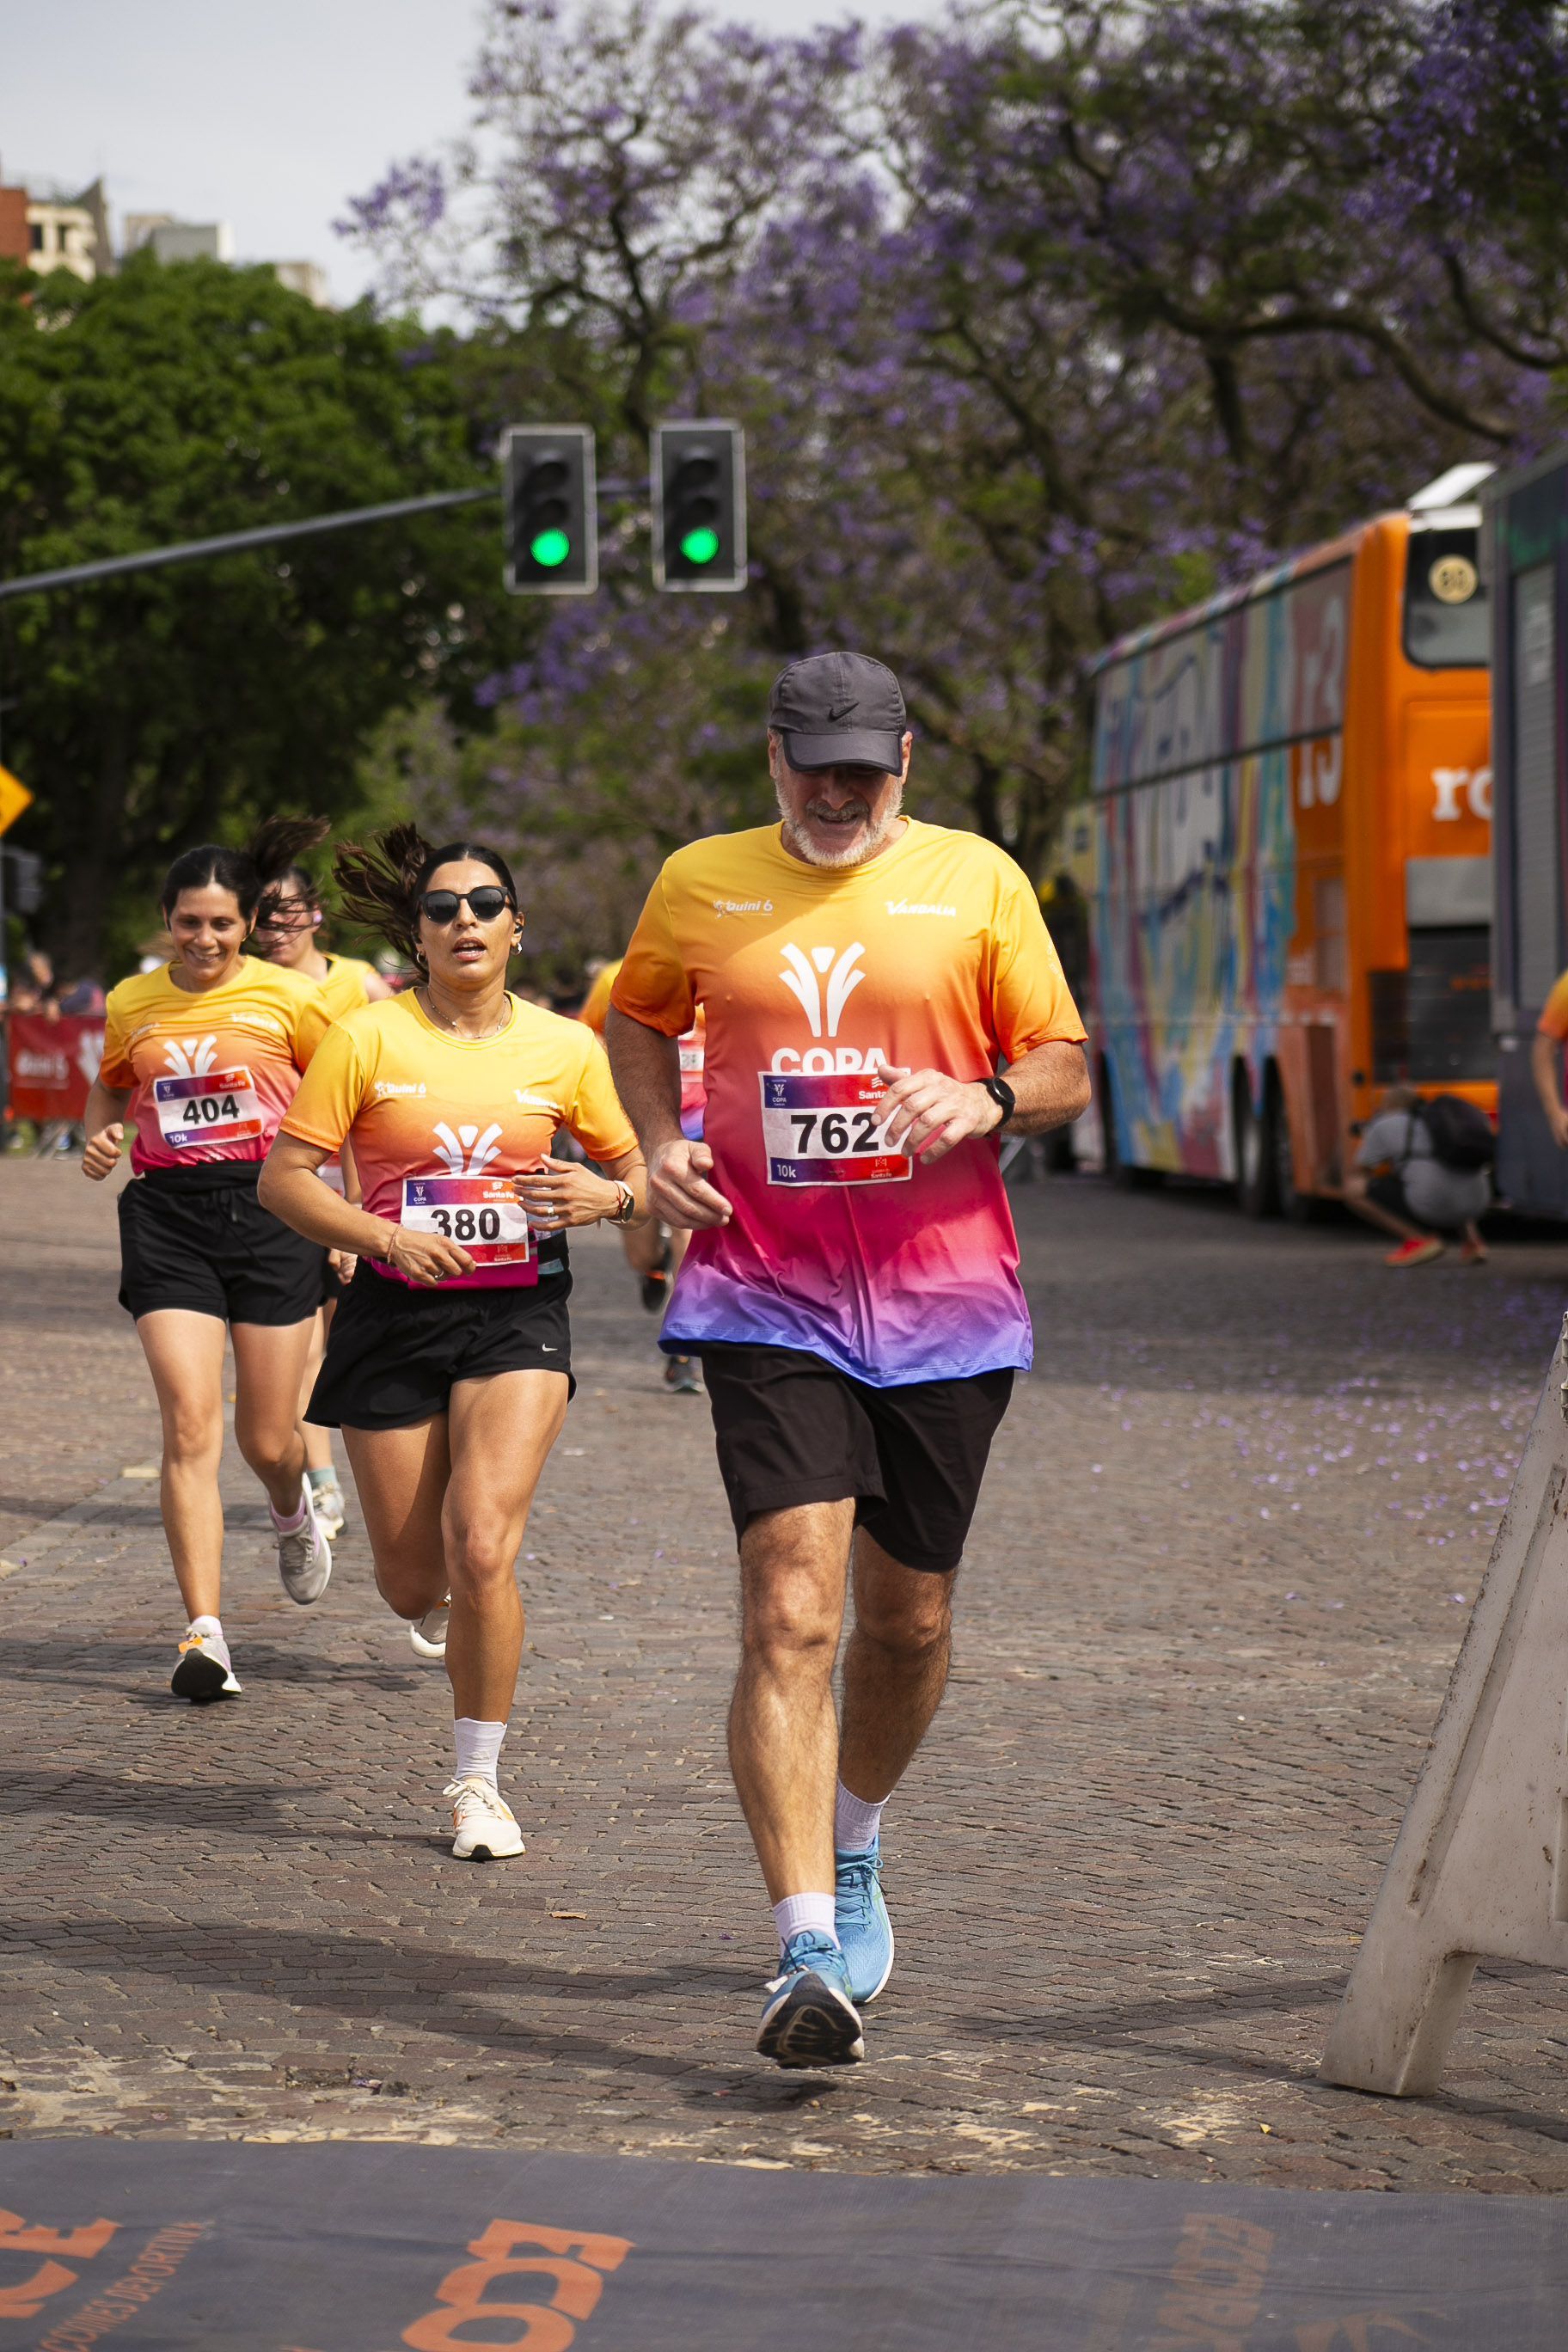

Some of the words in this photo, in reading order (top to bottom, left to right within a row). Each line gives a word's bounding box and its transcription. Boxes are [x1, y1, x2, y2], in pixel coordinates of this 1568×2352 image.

[763, 899, 773, 912] 6
[772, 1047, 888, 1073] COPA
[419, 1082, 427, 1094] 6
[183, 1094, 240, 1124] 404
[169, 1133, 187, 1143] 10k
[790, 1112, 879, 1154] 762
[776, 1164, 796, 1178] 10k
[430, 1208, 500, 1240] 380
